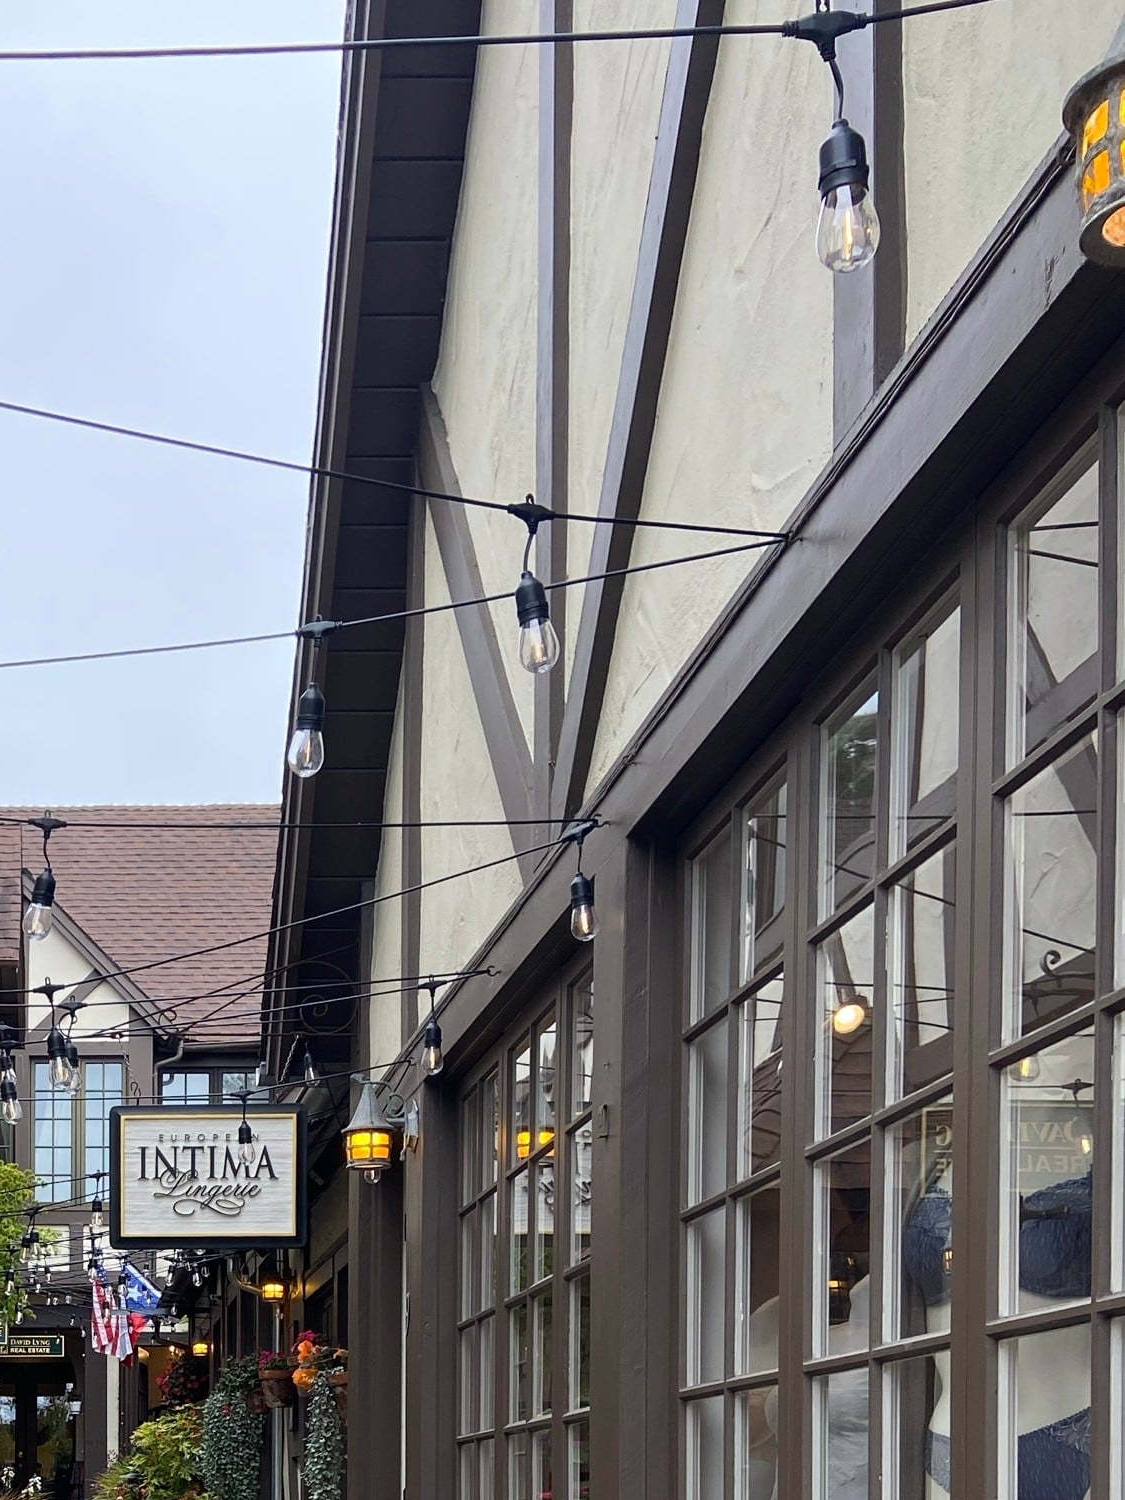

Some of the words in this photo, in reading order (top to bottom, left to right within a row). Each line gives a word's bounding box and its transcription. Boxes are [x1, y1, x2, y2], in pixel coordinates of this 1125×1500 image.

[158, 1133, 260, 1143] EUROPEN
[137, 1144, 279, 1181] INTIMA
[153, 1167, 263, 1217] Lingerie
[10, 1338, 31, 1346] DAVID
[32, 1338, 51, 1346] LYNG
